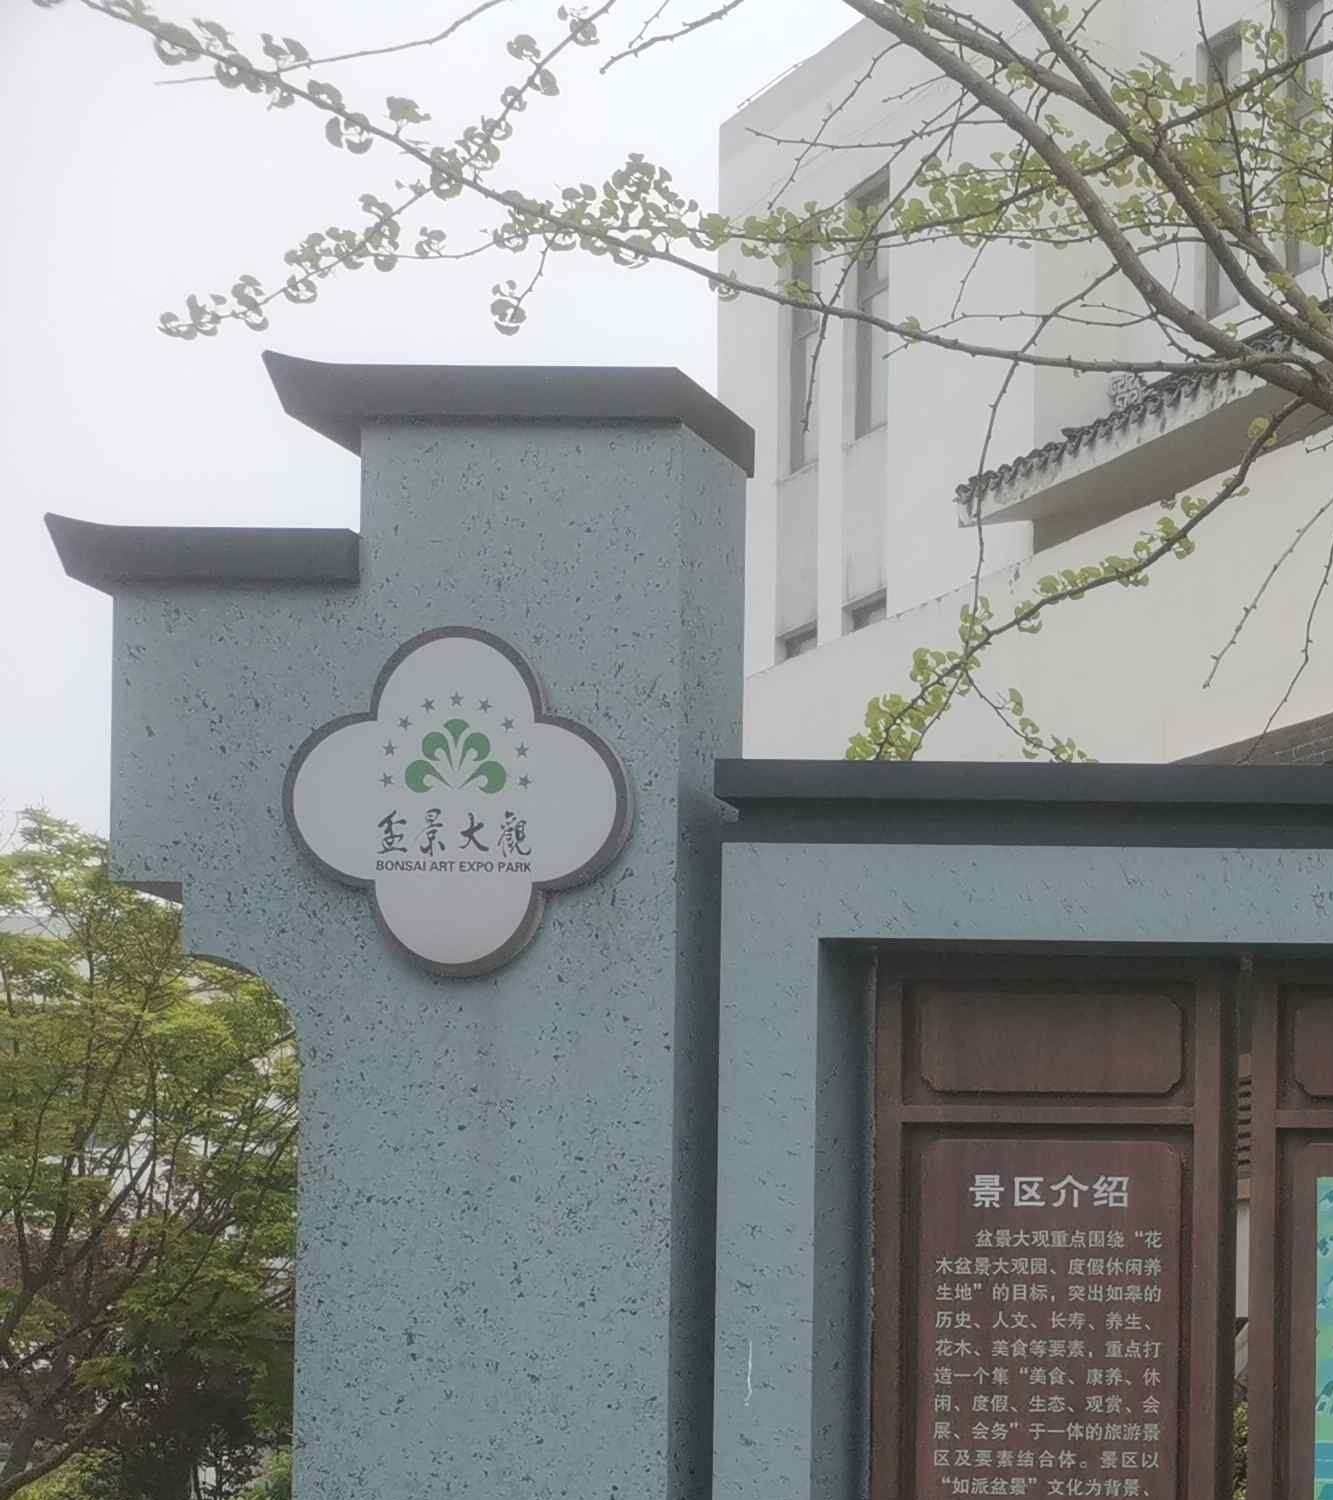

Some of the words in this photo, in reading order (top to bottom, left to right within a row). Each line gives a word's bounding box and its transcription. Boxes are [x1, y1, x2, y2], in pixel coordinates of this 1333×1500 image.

[375, 859, 427, 873] BONSAI
[429, 859, 456, 873] ART
[458, 860, 495, 874] EXPO
[497, 860, 533, 874] PARK
[967, 1173, 1130, 1209] 景区介绍
